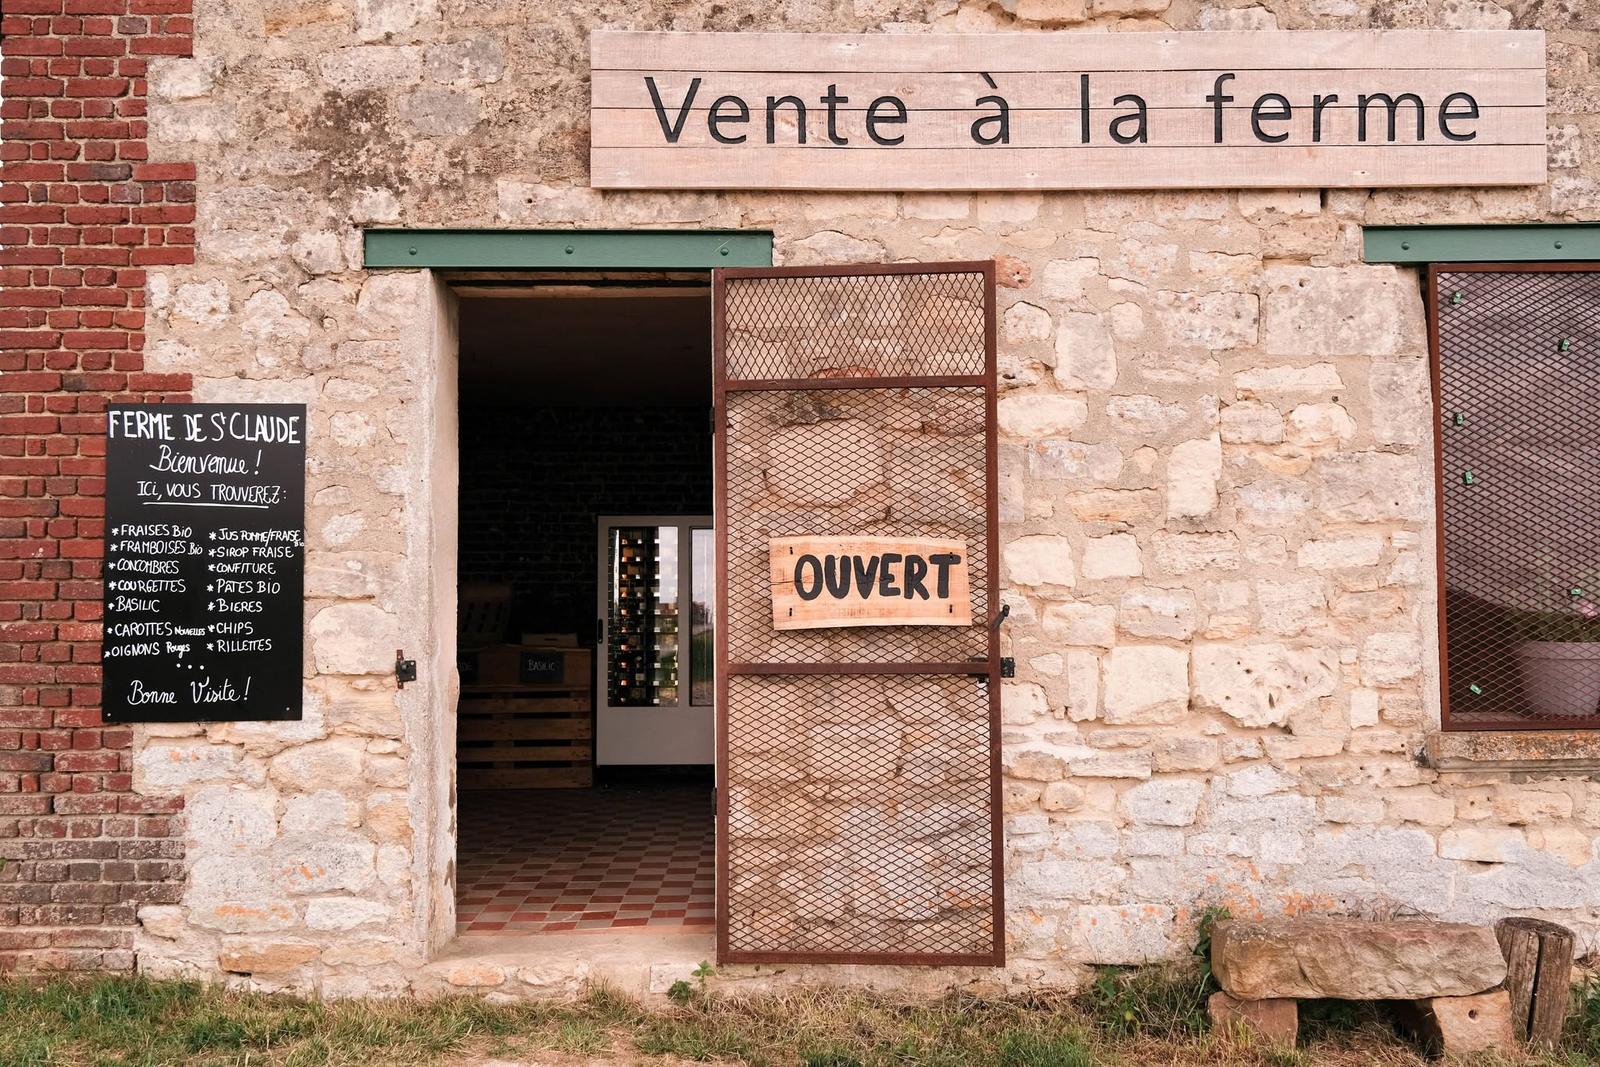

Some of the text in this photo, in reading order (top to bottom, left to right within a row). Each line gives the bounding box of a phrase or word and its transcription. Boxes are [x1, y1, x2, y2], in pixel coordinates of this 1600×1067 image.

[644, 72, 1480, 146] Vente à la ferme
[108, 411, 175, 440] FERME
[183, 414, 207, 442] DE
[230, 412, 300, 444] CLAUDE
[150, 445, 249, 474] Bienvenue
[166, 483, 201, 498] VOUS
[121, 524, 170, 537] FRAISES
[120, 540, 187, 555] FRAMBOISES
[216, 546, 294, 558] SIROP FRAISE
[117, 558, 180, 574] CONCOMBRES
[216, 562, 276, 574] CONFITURE
[794, 553, 961, 600] OUVERT
[118, 579, 186, 593] COURGETTES
[115, 595, 160, 613] BASILIC
[216, 598, 263, 612] BIERES
[114, 621, 172, 637] CAROTTES
[216, 621, 254, 635] CHIPS
[111, 641, 160, 657] OIGNONS
[216, 638, 272, 652] RILLETTES
[127, 679, 177, 705] Bonne
